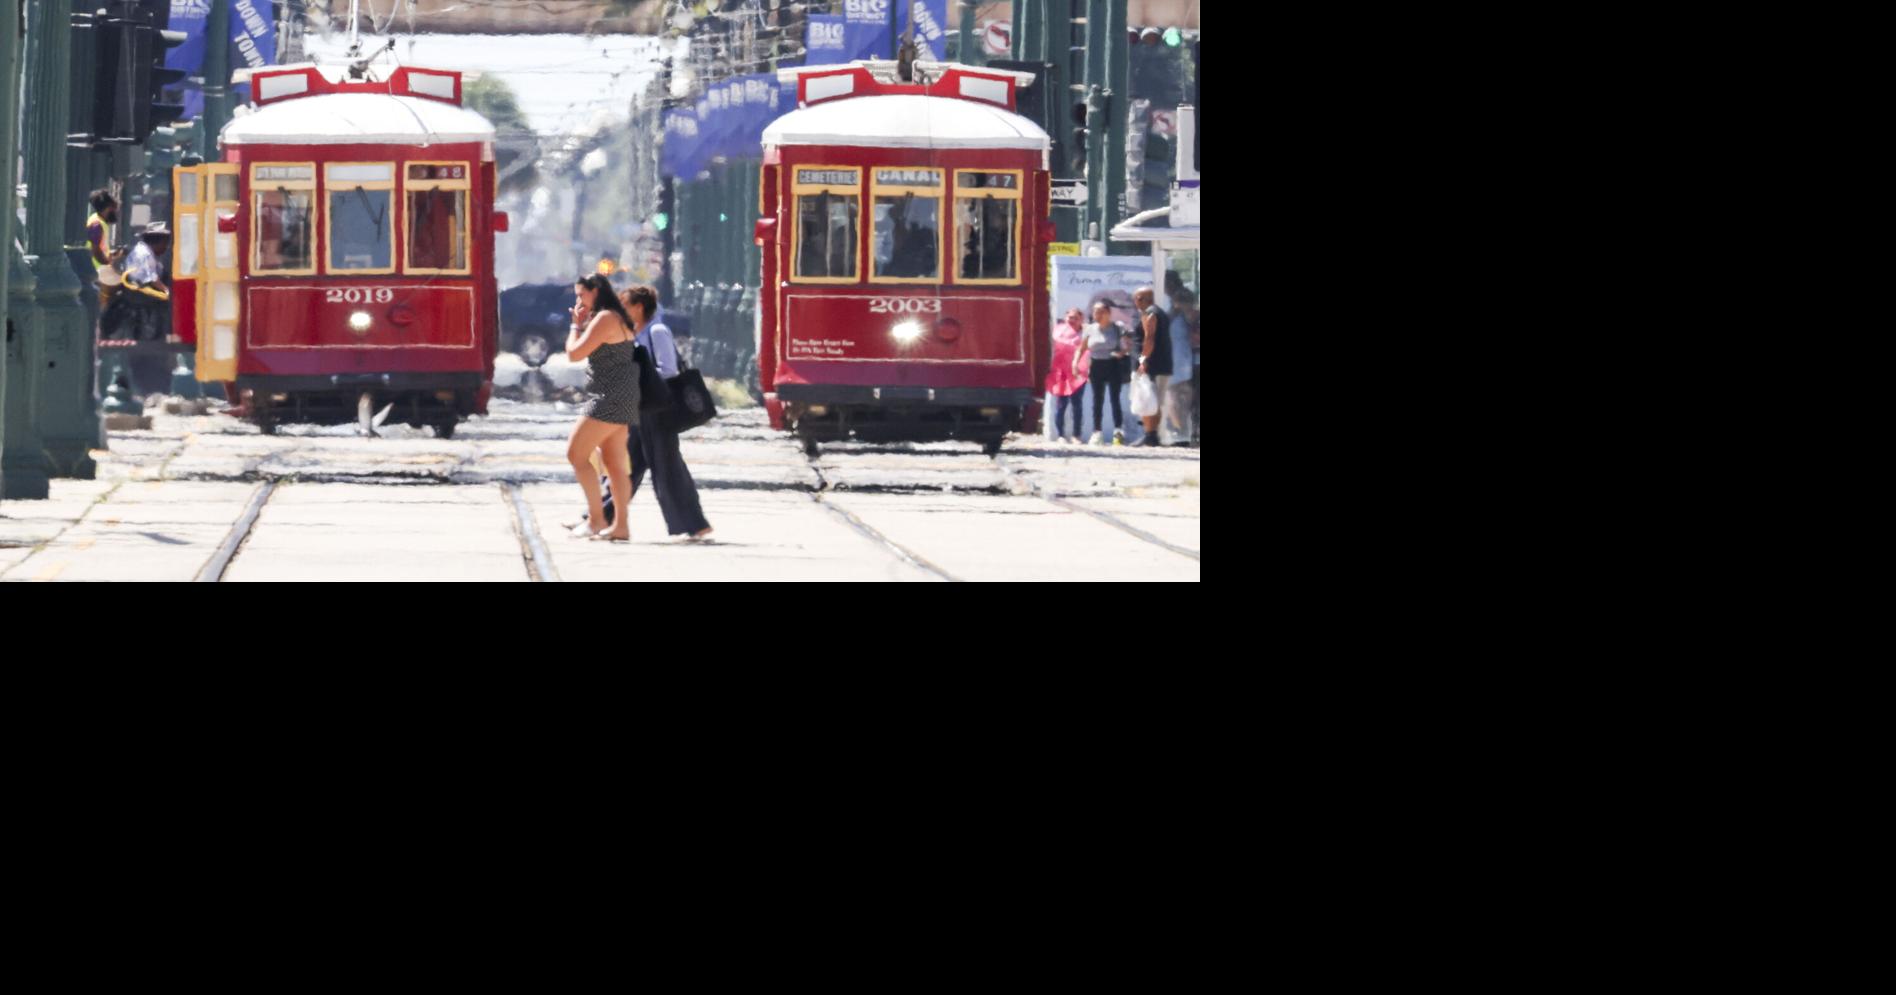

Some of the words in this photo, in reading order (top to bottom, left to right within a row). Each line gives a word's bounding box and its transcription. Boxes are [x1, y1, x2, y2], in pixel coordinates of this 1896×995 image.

[235, 0, 269, 38] DOWN
[800, 170, 858, 184] CEMETERIES
[877, 170, 940, 181] CANAL
[326, 288, 394, 304] 2019
[869, 298, 942, 313] 2003
